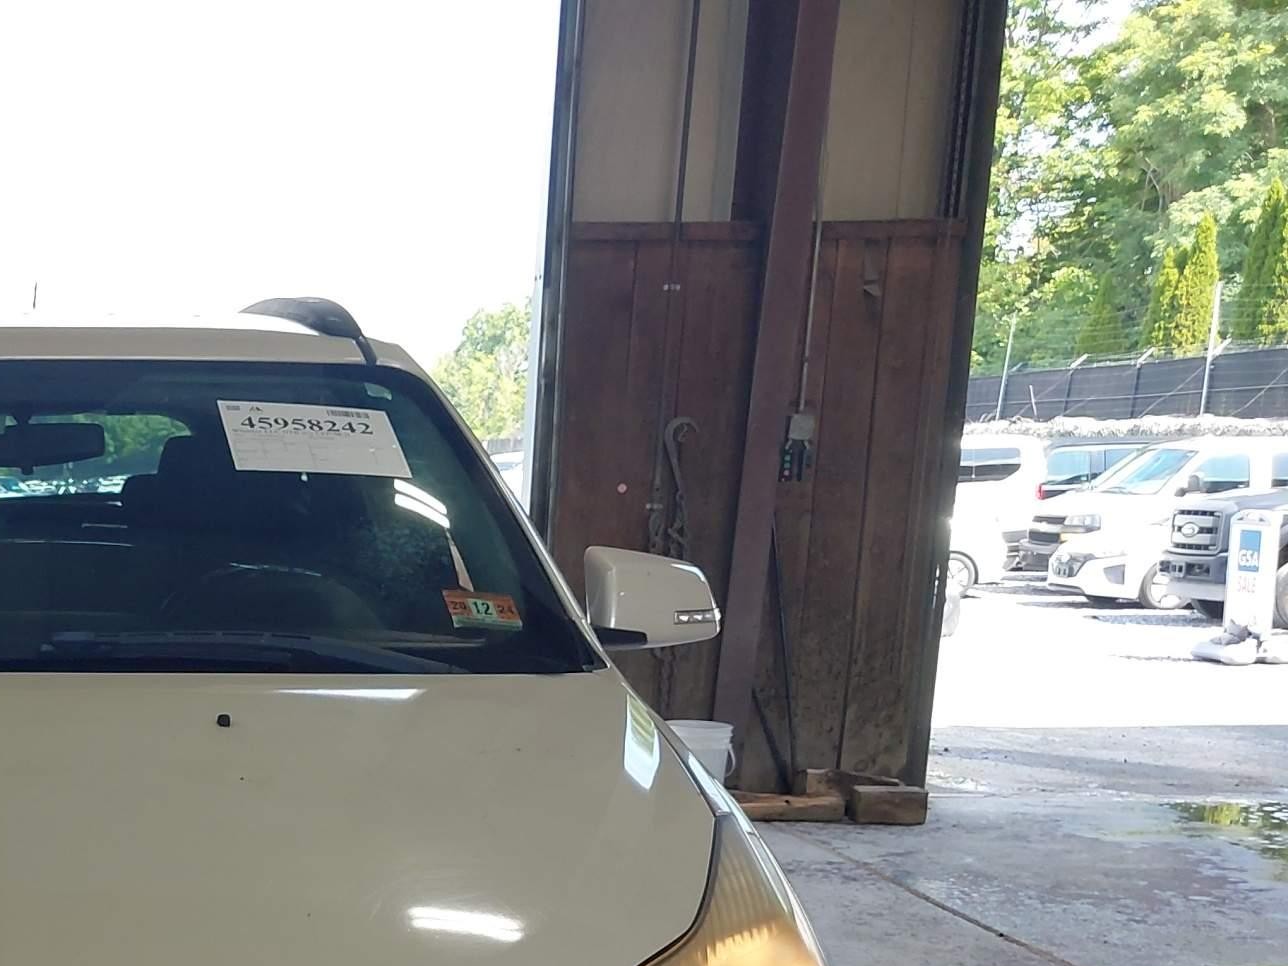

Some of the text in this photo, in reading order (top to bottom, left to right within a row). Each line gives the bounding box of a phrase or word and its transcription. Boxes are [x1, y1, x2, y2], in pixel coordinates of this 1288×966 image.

[240, 415, 374, 436] 45958242
[1238, 549, 1259, 568] GSA
[472, 601, 494, 615] 12
